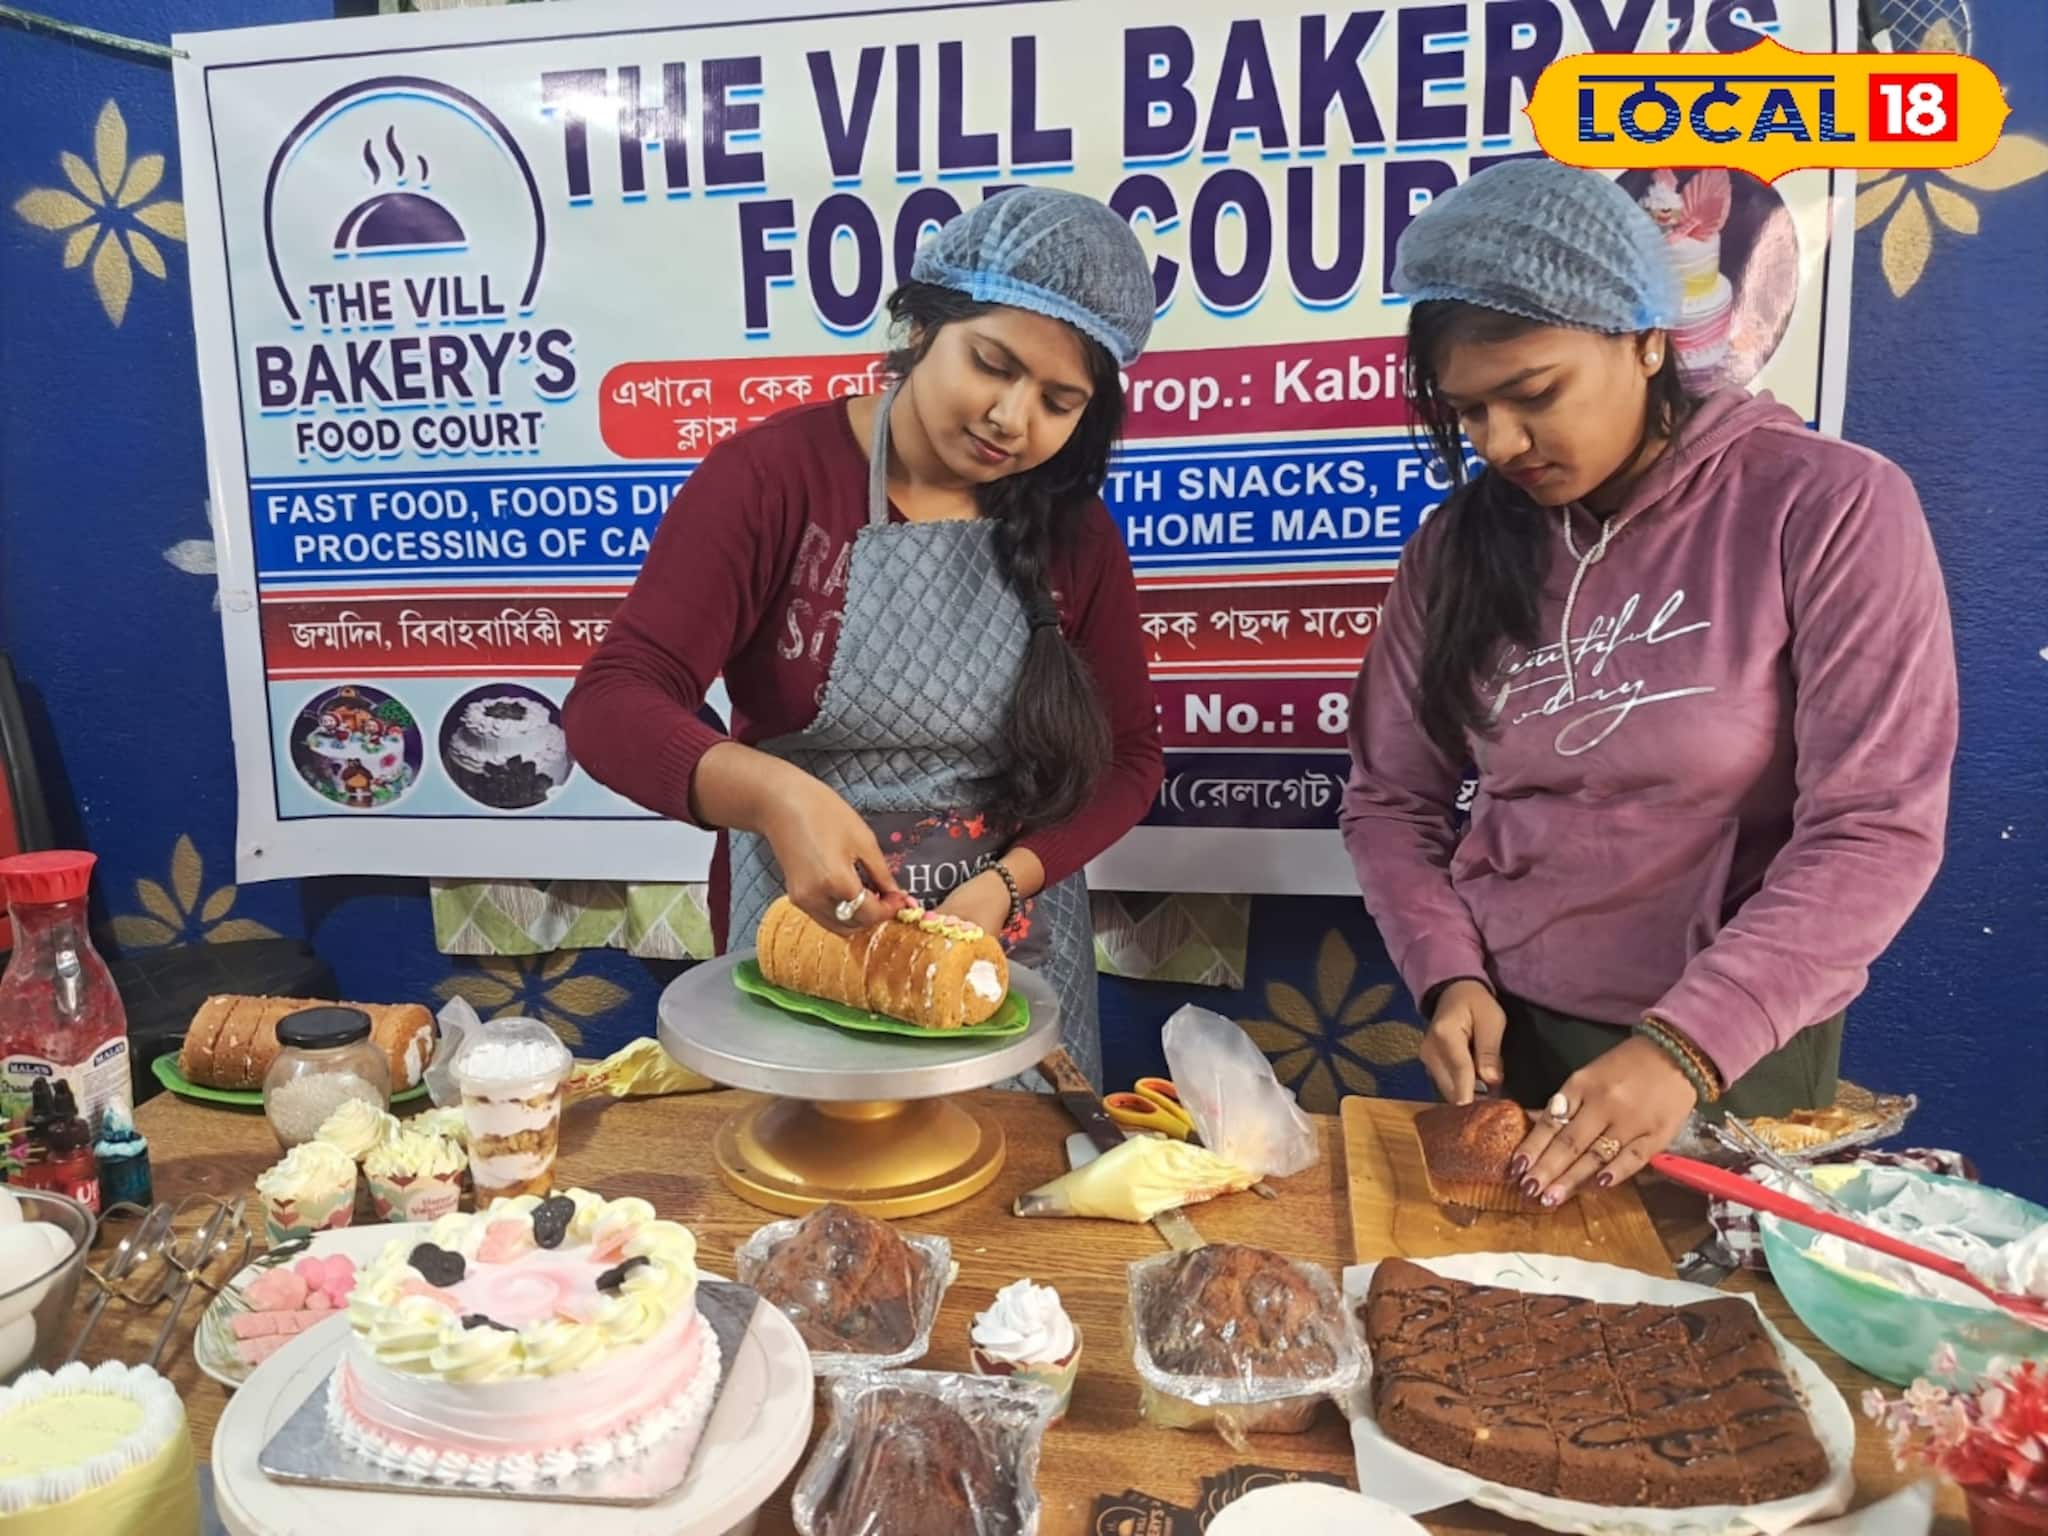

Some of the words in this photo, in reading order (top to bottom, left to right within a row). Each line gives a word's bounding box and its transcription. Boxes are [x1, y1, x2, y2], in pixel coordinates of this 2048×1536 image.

[541, 56, 767, 206] THE
[805, 35, 1074, 187] VILL
[309, 280, 395, 334] THE
[405, 275, 507, 327] VILL
[255, 329, 578, 417] BAKERY'S
[612, 376, 712, 407] এখানে
[739, 374, 812, 405] কেক
[296, 418, 401, 464] FOOD
[412, 411, 544, 458] COURT
[1178, 459, 1378, 501] SNACKS,
[268, 493, 357, 524] FAST
[370, 489, 479, 523] FOOD,
[491, 484, 618, 517] FOODS
[632, 484, 684, 515] DI
[294, 528, 527, 563] PROCESSING
[538, 527, 587, 557] OF
[601, 526, 658, 557] CA
[1127, 510, 1254, 548] HOME
[1271, 505, 1402, 542] MADE
[289, 611, 392, 651] জন্মদিন,
[1184, 692, 1295, 734] No.:
